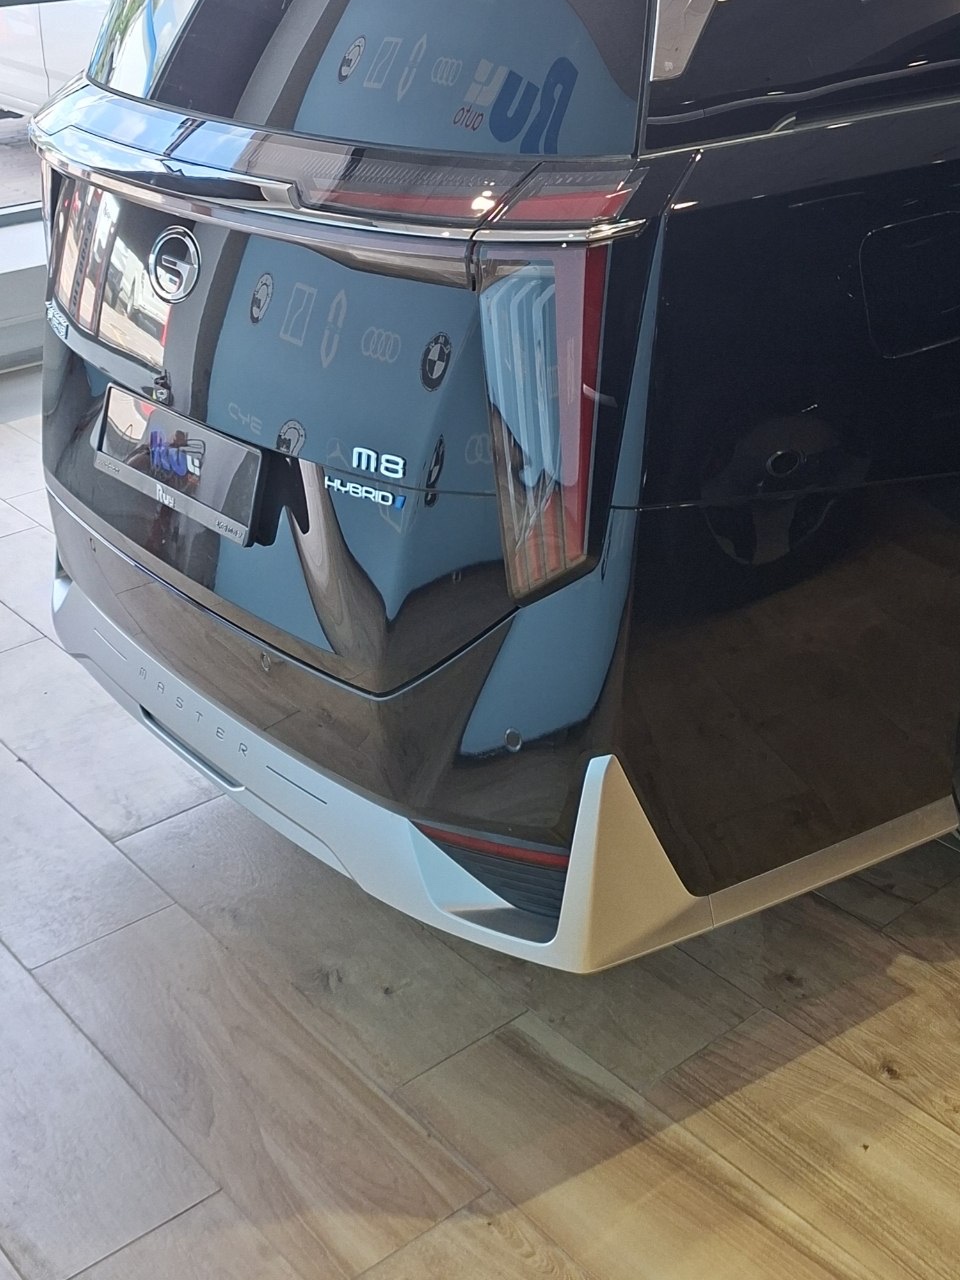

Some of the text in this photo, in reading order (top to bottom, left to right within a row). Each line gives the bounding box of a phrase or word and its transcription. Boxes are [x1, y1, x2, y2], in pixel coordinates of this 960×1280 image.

[352, 446, 407, 479] M8
[324, 475, 395, 506] HYBRID
[139, 666, 248, 757] MASTER
